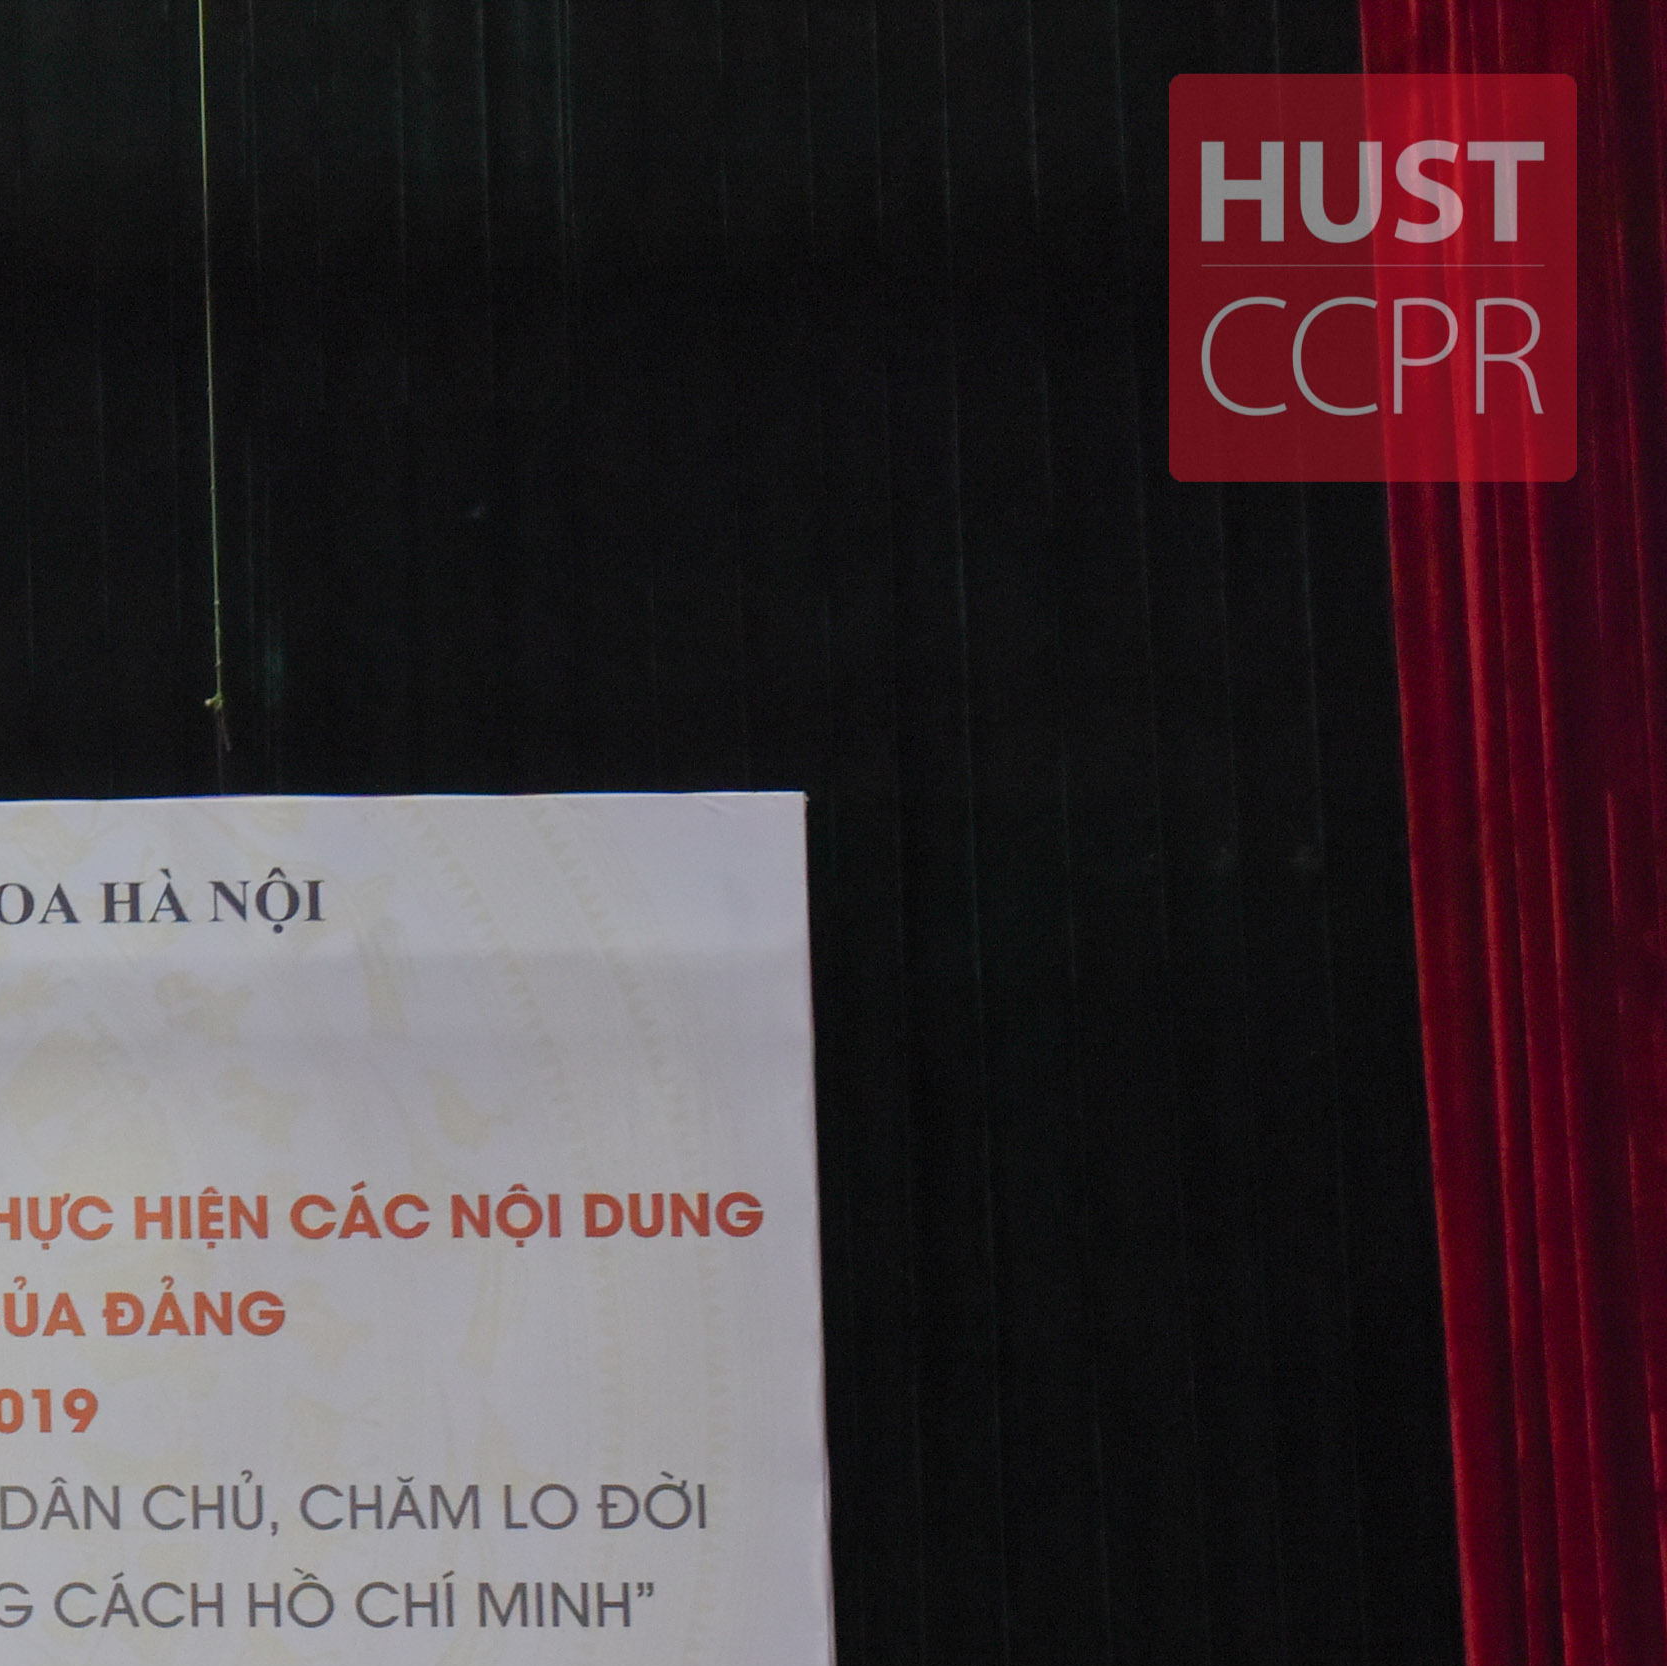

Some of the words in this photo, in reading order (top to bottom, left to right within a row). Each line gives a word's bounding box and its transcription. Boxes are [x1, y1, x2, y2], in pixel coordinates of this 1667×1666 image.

[100, 867, 192, 924] HÀ
[208, 866, 326, 934] NỘI
[133, 1185, 269, 1250] HIỆN
[289, 1180, 431, 1241] CÁC
[450, 1183, 562, 1249] NỘI
[583, 1191, 764, 1239] DUNG
[102, 1274, 287, 1337] ĐẢNG
[0, 1476, 121, 1531] DÂN
[142, 1469, 279, 1537] CHỦ,
[299, 1476, 481, 1531] CHĂM
[503, 1482, 579, 1531] LO
[596, 1470, 707, 1531] ĐỜI
[53, 1571, 225, 1629] CÁCH
[247, 1567, 335, 1629] HỒ
[355, 1569, 455, 1629] CHÍ
[477, 1581, 655, 1628] MINH”
